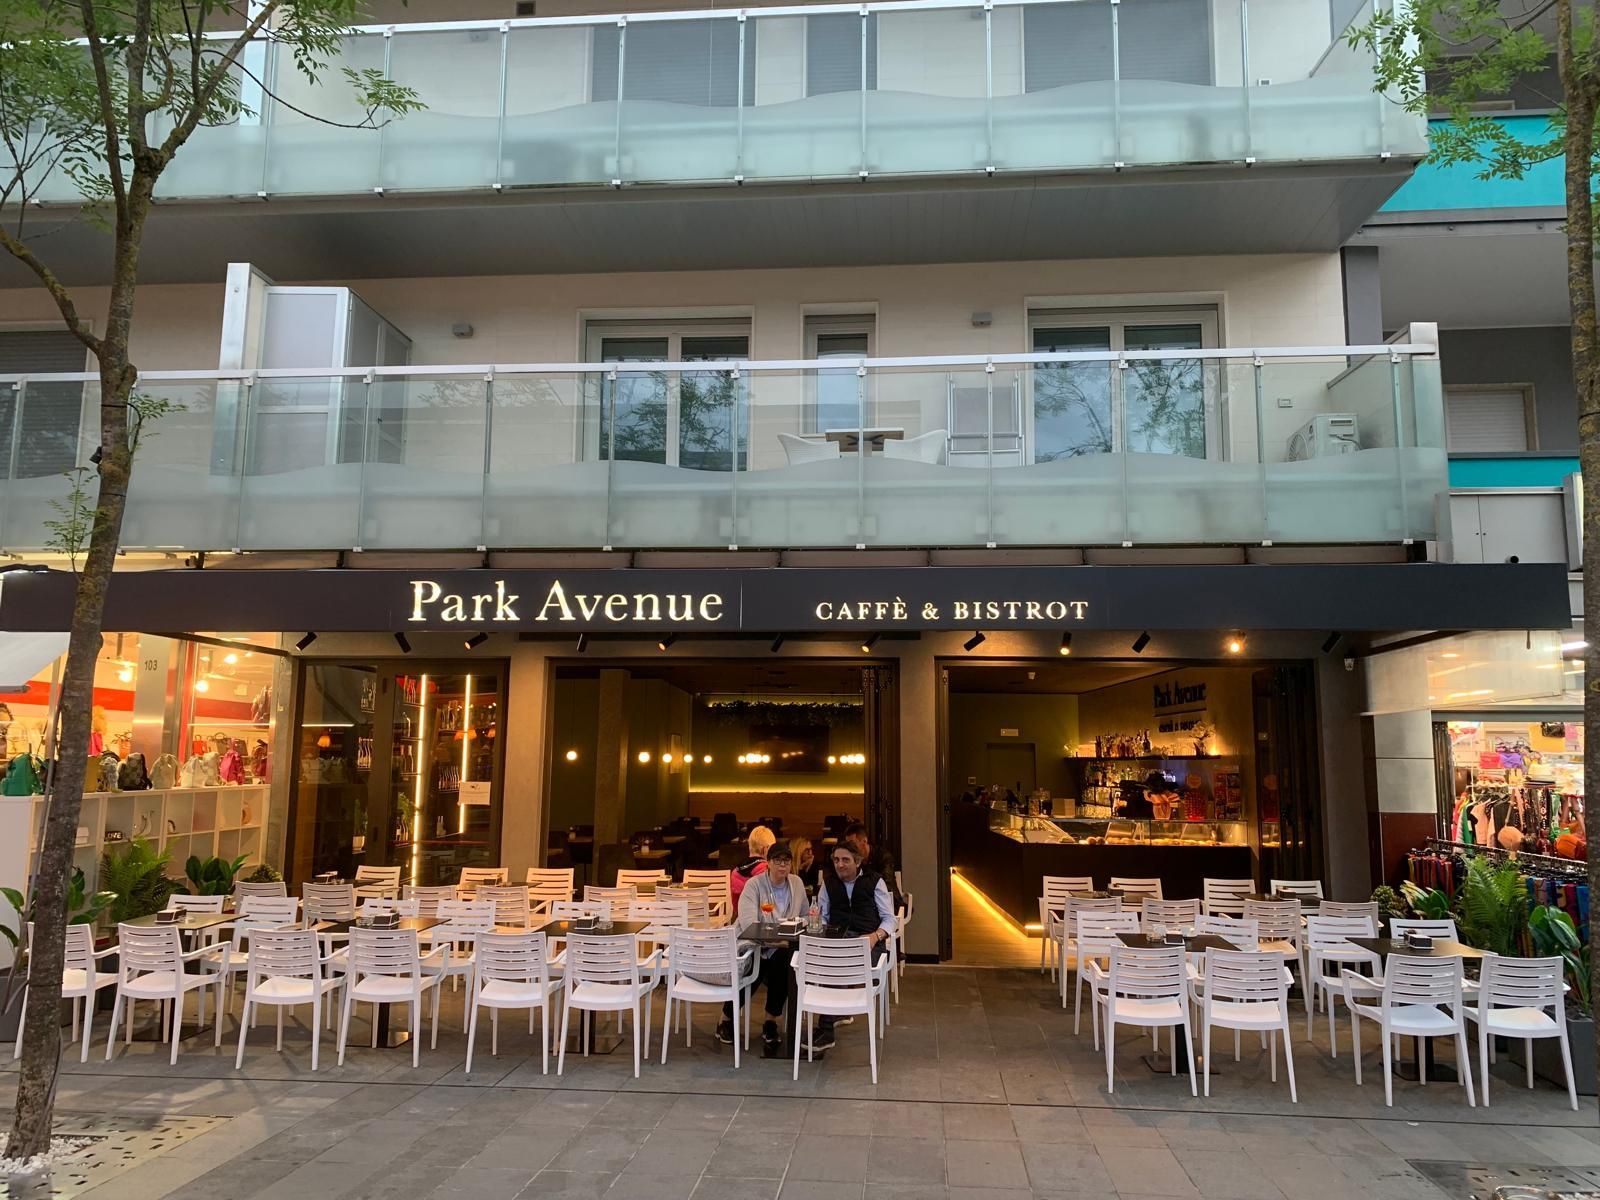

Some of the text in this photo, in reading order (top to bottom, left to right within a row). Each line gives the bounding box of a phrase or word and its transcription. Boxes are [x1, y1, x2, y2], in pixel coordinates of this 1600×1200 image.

[408, 580, 722, 621] Park Avenue
[816, 597, 1088, 620] CAFFÈ & BISTROT
[144, 659, 158, 671] 103
